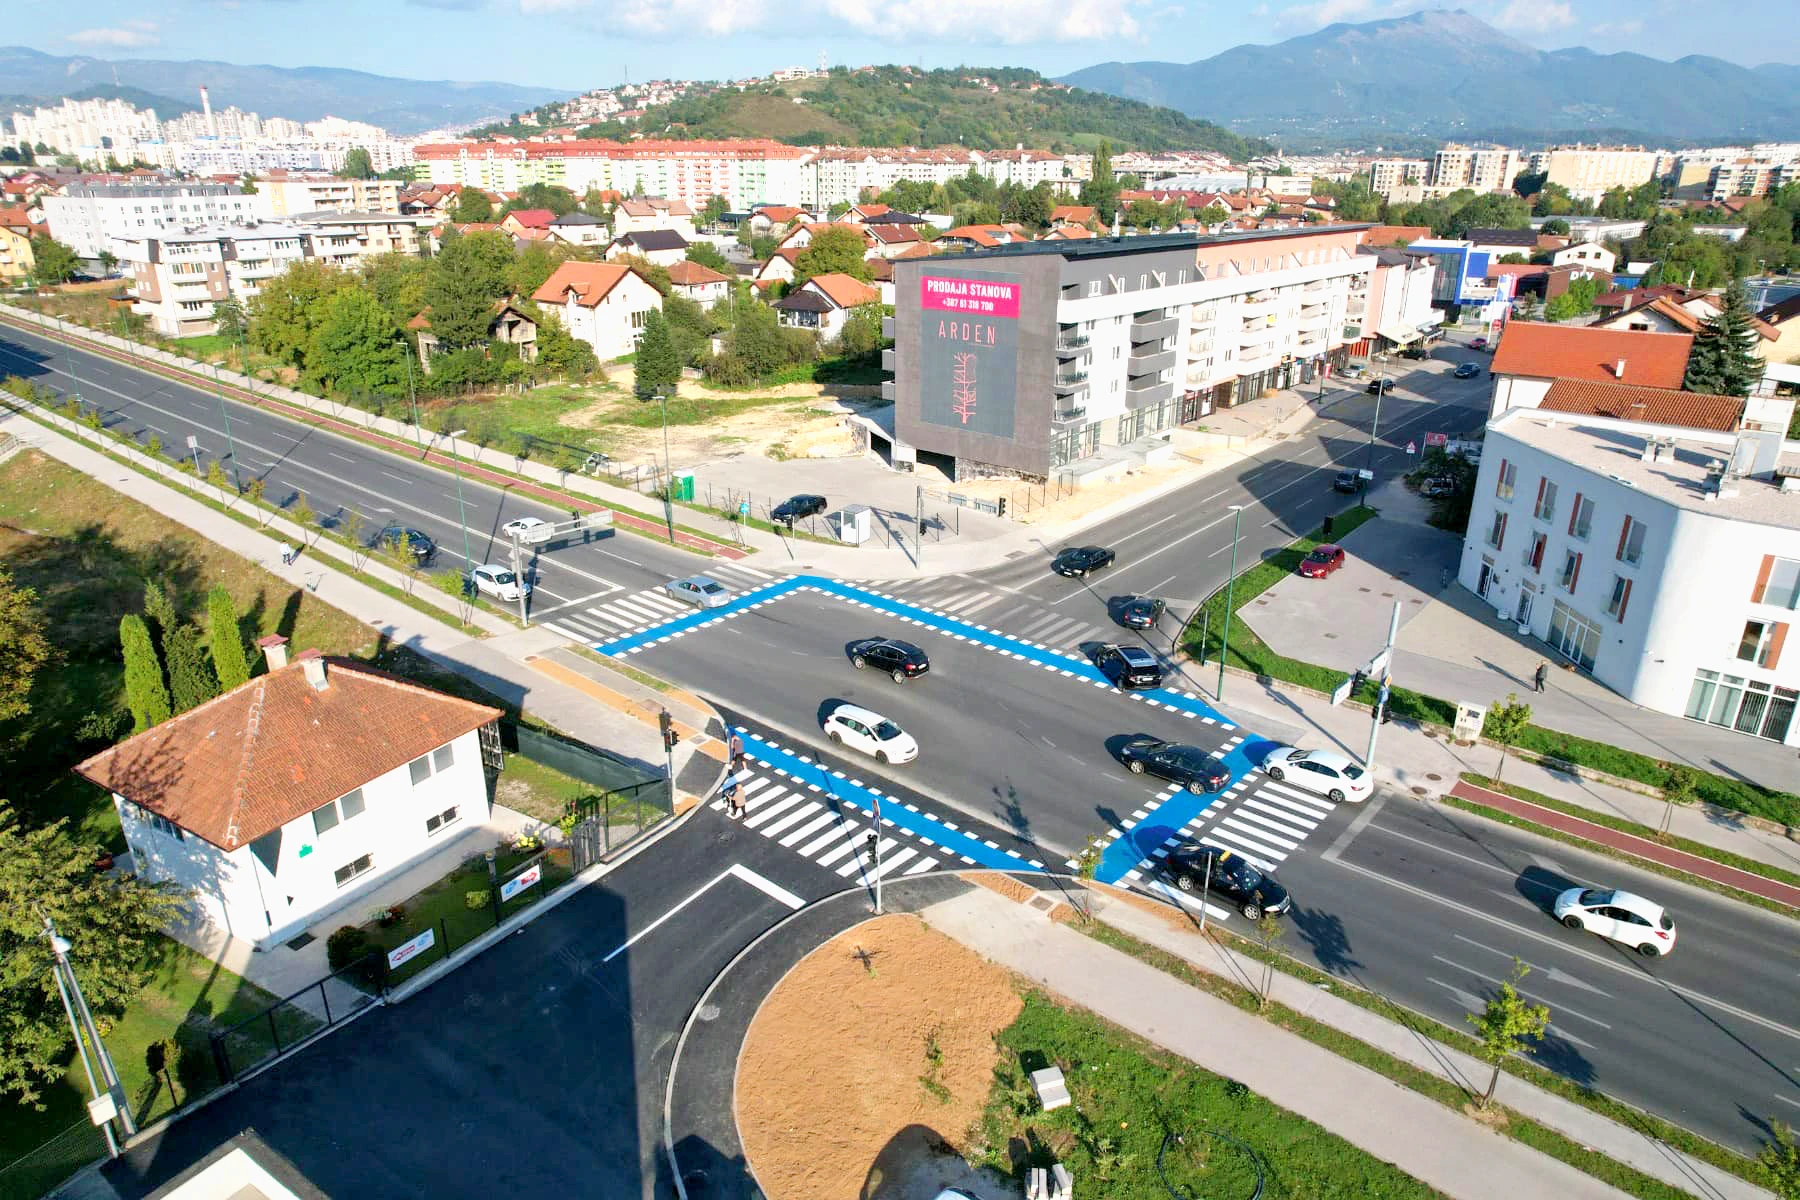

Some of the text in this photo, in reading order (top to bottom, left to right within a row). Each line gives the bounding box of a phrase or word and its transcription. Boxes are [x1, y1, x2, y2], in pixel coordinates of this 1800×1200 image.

[927, 280, 1011, 299] PRODAJA STANOVA
[942, 297, 959, 308] +387
[981, 301, 994, 311] 700
[938, 320, 995, 344] ARDEN
